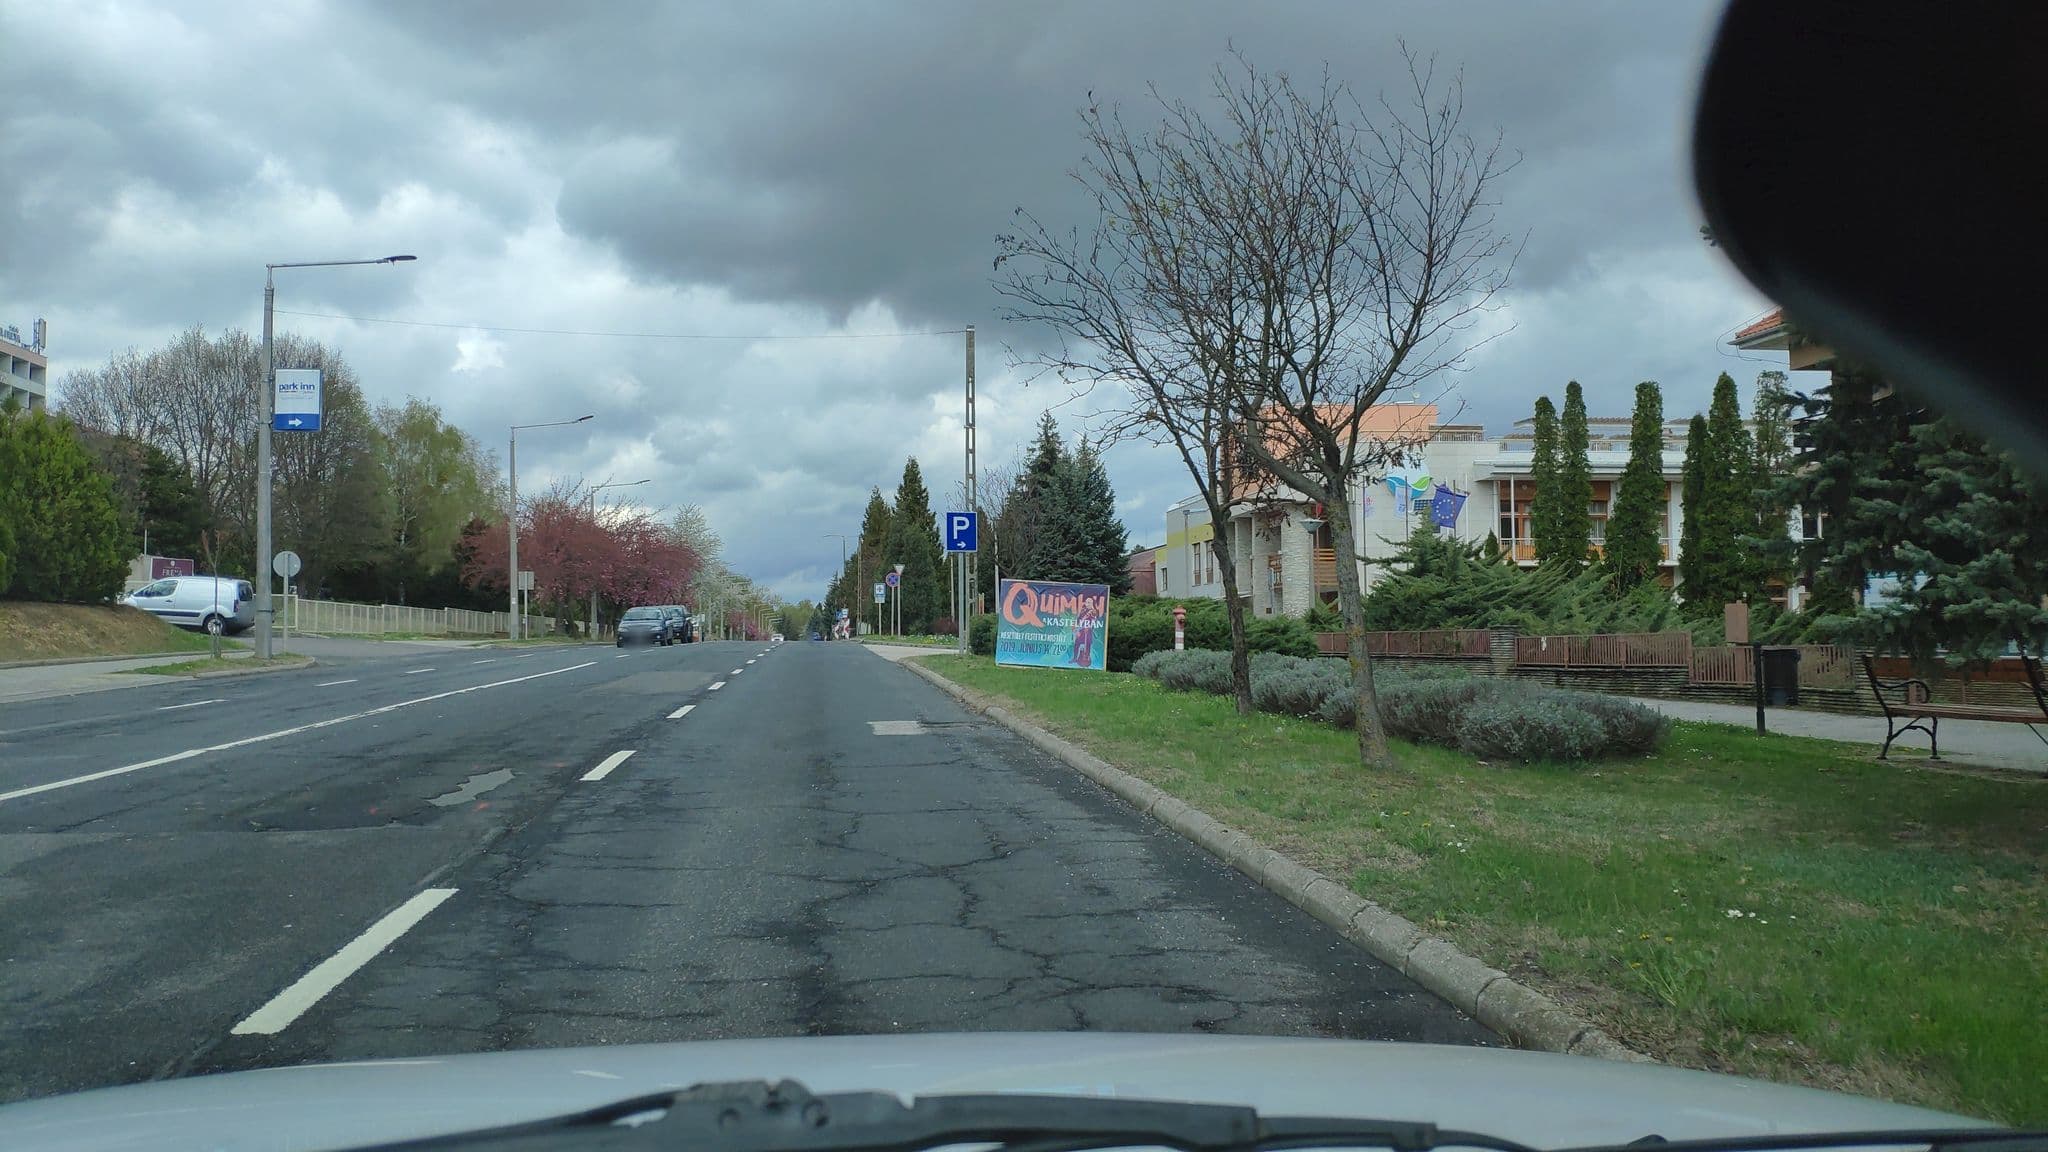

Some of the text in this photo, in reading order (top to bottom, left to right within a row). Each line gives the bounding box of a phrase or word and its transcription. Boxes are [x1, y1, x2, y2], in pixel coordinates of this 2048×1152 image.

[279, 382, 298, 393] park
[300, 382, 315, 390] inn
[953, 516, 970, 540] P
